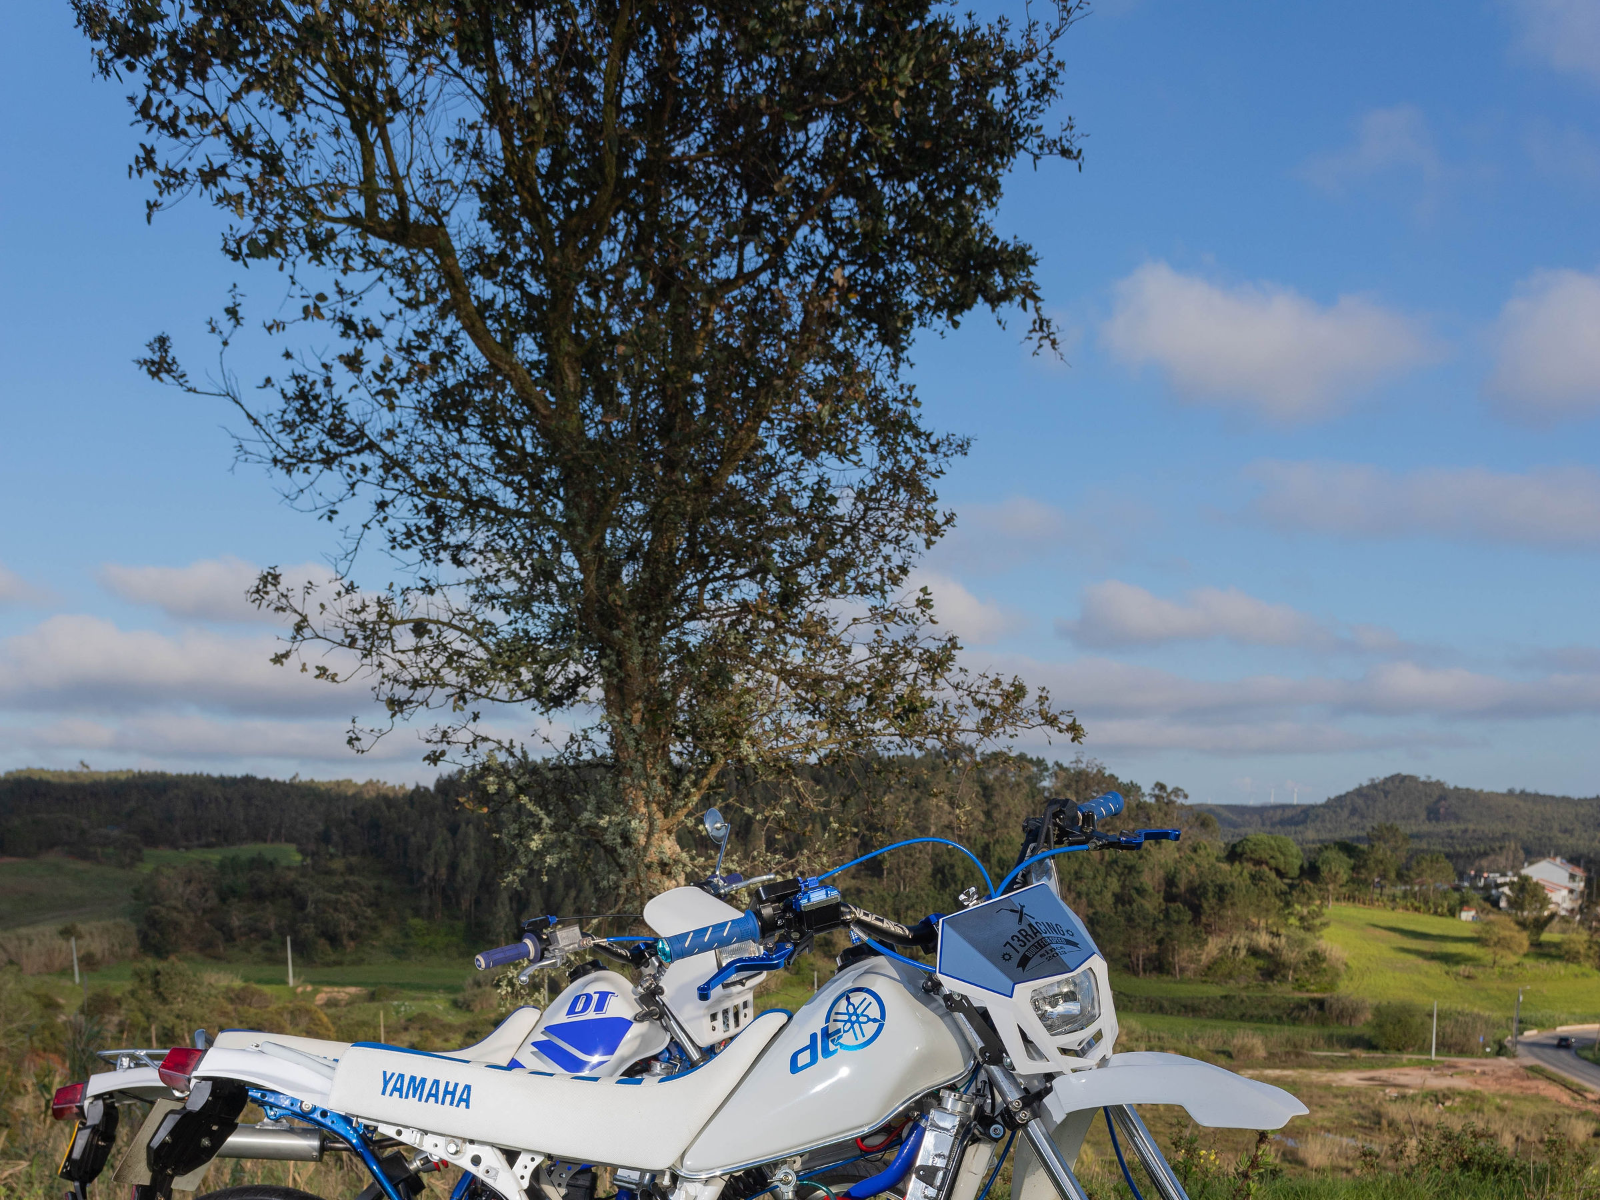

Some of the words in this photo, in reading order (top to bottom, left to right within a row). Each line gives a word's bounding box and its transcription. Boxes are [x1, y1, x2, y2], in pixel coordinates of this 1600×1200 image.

[1003, 921, 1066, 954] 73RACING
[1025, 942, 1040, 958] BUILT
[565, 990, 619, 1019] DT
[789, 1024, 842, 1075] dt
[381, 1070, 472, 1110] YAMAHA
